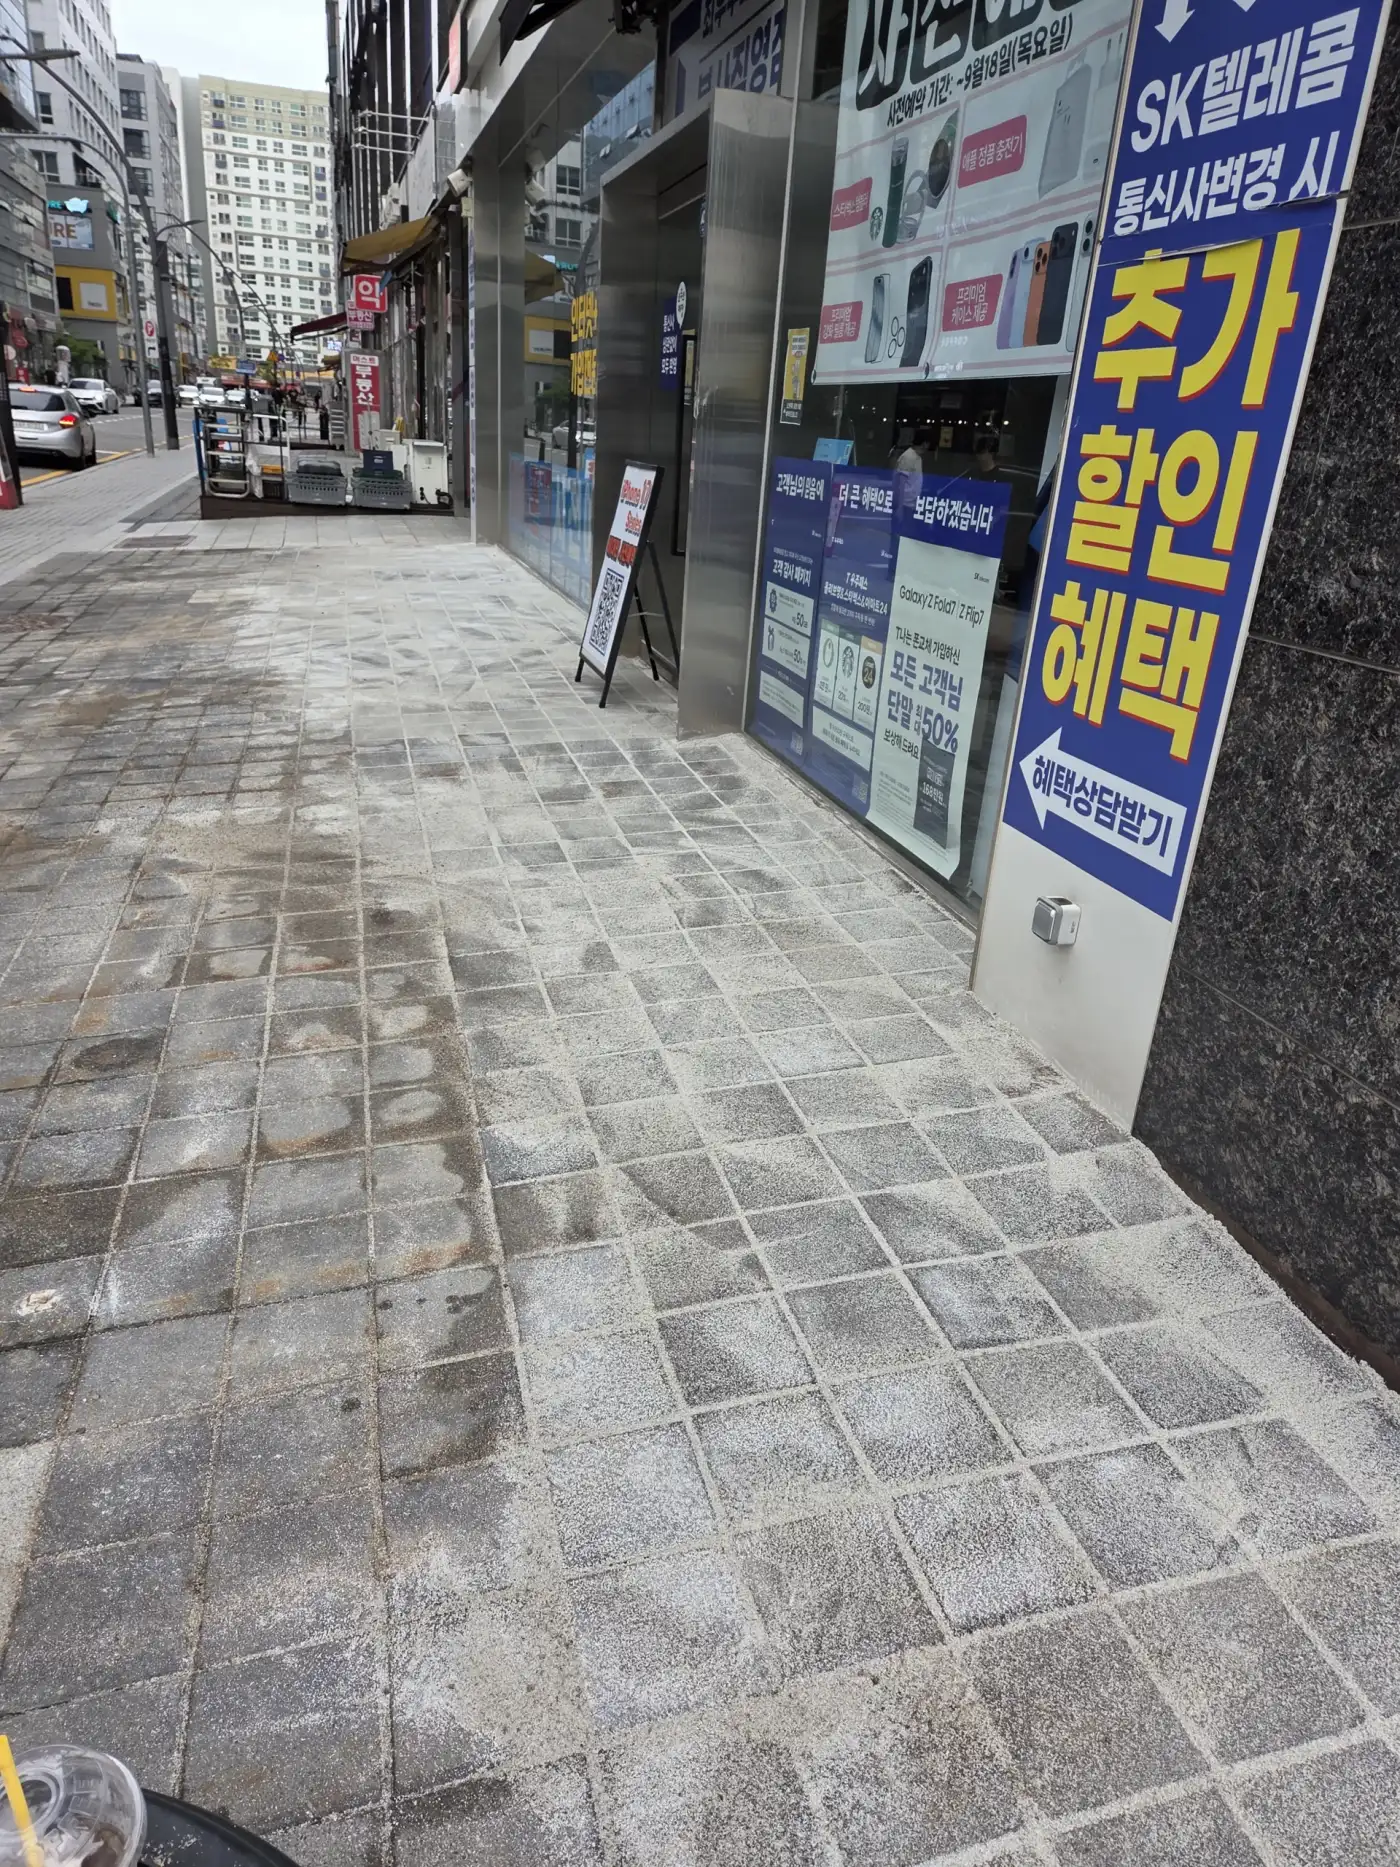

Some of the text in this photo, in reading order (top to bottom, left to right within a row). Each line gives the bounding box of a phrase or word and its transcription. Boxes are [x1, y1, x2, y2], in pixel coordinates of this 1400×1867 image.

[886, 83, 926, 127] 사전예약
[928, 73, 953, 108] 기간:
[1131, 7, 1360, 152] SK텔레콤
[962, 132, 1023, 171] 애플 정품 충전기
[1113, 130, 1340, 236] 통신사변경 시
[951, 302, 988, 324] 케이스 제공
[957, 281, 986, 304] 프리미엄
[1094, 228, 1300, 413] 추가
[355, 365, 375, 405] 부동산
[839, 483, 893, 513] 더 큰 혜택으로
[913, 495, 993, 535] 보답하겠습니다
[1066, 424, 1259, 595] 할인
[900, 585, 984, 628] Galaxy Z Fold7 Z Flip7
[933, 641, 961, 667] 가입하신
[1042, 580, 1220, 765] 혜택
[890, 650, 964, 712] 모든 고객님
[883, 728, 902, 750] 보상해
[902, 737, 919, 760] 드려요
[887, 689, 960, 754] 단말 최대 50%
[1032, 755, 1173, 858] 혜택상담받기
